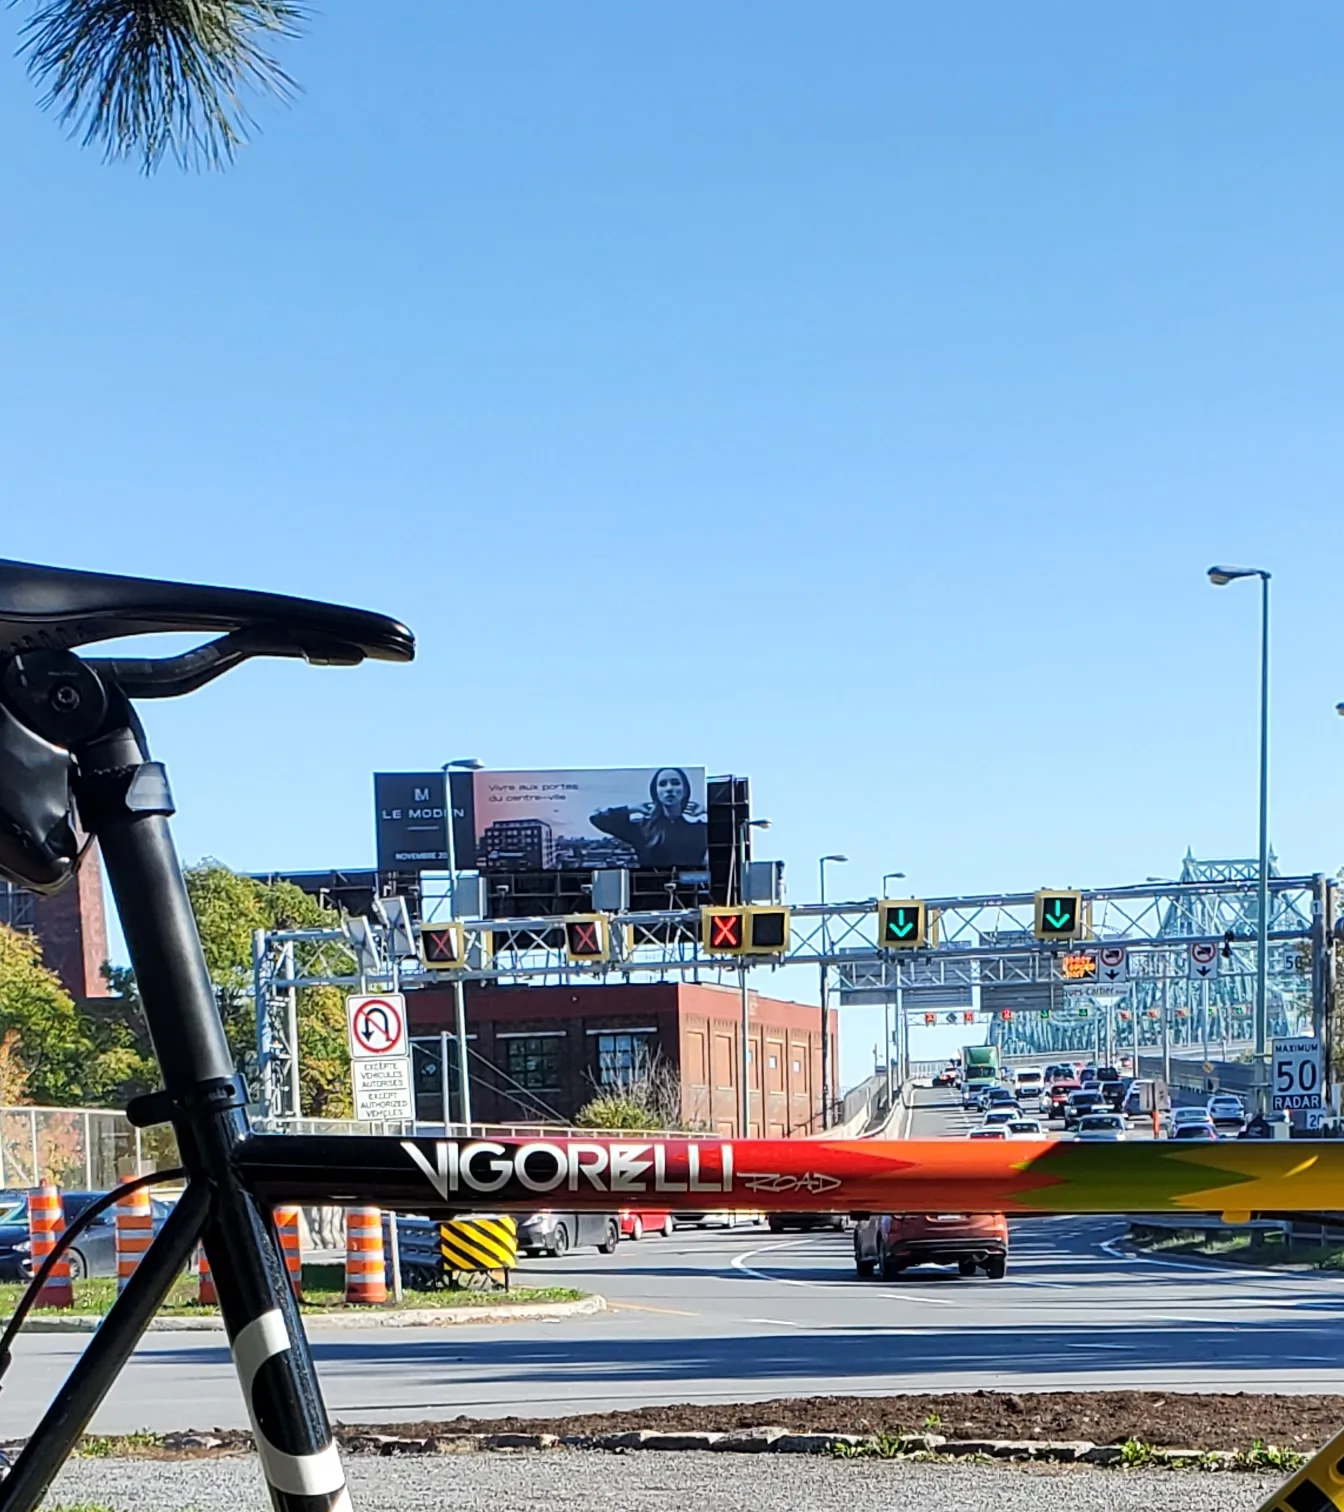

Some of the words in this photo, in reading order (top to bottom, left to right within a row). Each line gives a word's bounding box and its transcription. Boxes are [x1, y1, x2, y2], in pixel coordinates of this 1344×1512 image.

[542, 783, 579, 792] portes
[382, 810, 402, 819] LE
[1275, 1044, 1318, 1053] MAXIMUM
[1277, 1059, 1317, 1093] 50
[1274, 1095, 1320, 1109] RADAR
[400, 1142, 733, 1200] VIGORELLI
